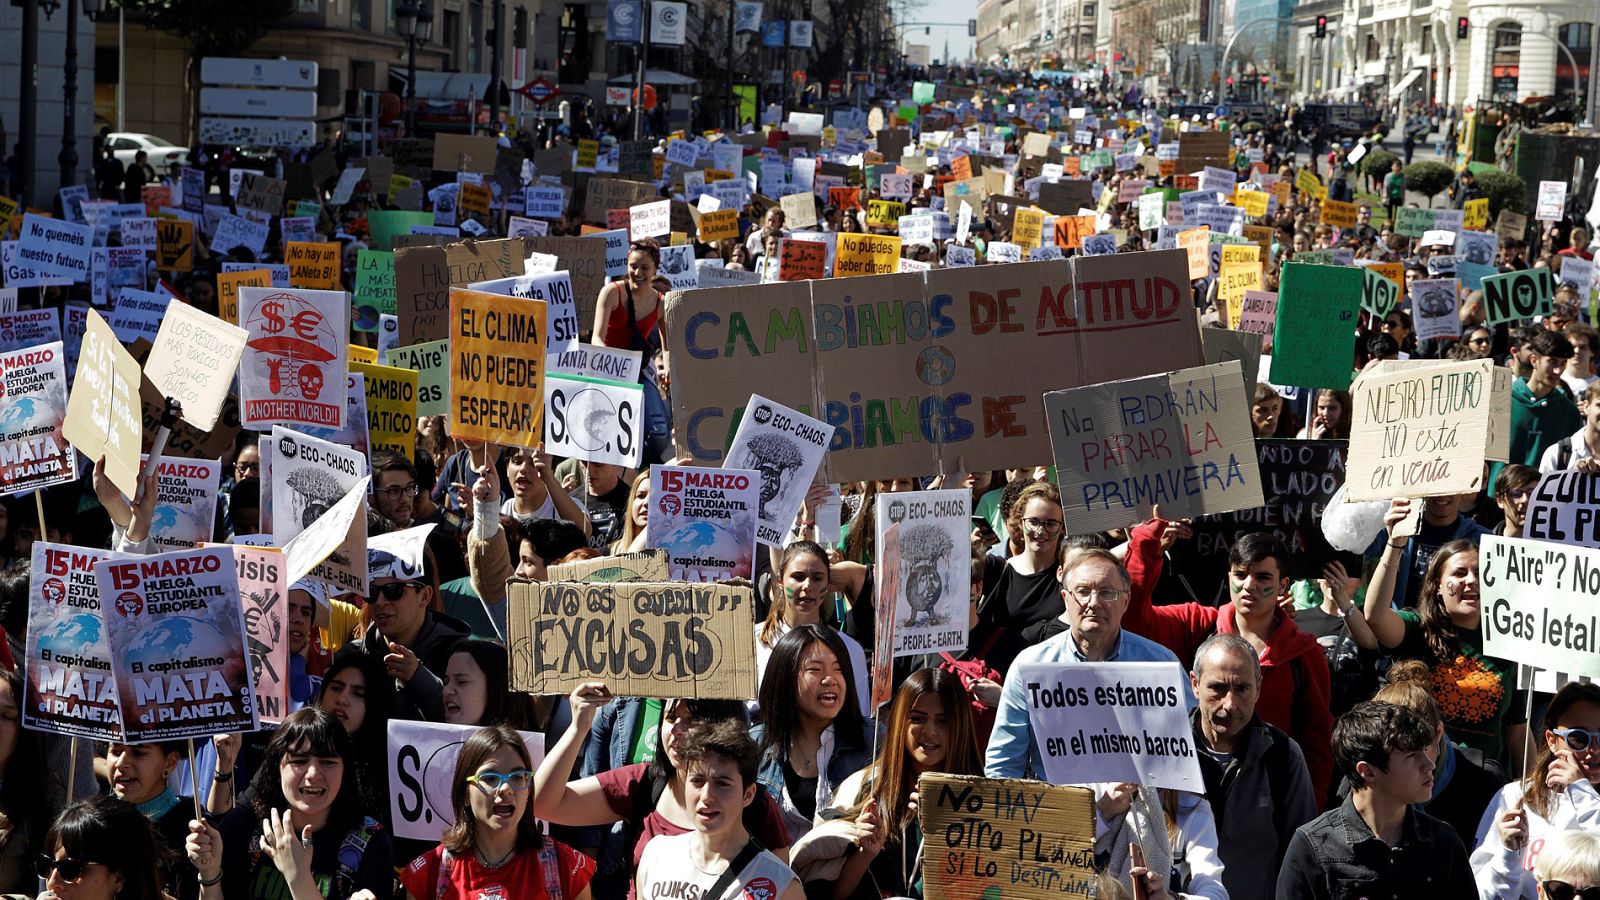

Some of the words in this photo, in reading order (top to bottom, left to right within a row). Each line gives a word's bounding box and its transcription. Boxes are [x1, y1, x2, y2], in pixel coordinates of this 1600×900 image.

[528, 192, 535, 200] EL
[535, 191, 561, 200] PROBLEMA
[650, 220, 666, 231] CLIMA
[703, 213, 713, 222] No
[713, 211, 726, 221] hay
[31, 223, 43, 237] No
[46, 228, 85, 246] queméis
[305, 245, 321, 263] hay
[323, 247, 335, 258] un
[842, 238, 856, 251] No
[858, 239, 893, 255] puedes
[1224, 251, 1233, 262] EL
[1234, 251, 1255, 262] CLIMA
[20, 248, 53, 263] nuestro
[56, 252, 86, 271] futuro.
[362, 256, 378, 271] LA
[837, 257, 863, 271] beber
[864, 258, 894, 274] dinero.
[1228, 275, 1237, 289] EL
[1237, 271, 1257, 289] CLIMA
[118, 295, 138, 307] Todos
[549, 280, 572, 305] NO!
[1363, 274, 1397, 316] NO!
[1484, 272, 1550, 322] NO!
[1243, 298, 1264, 313] CAMBIA
[0, 315, 14, 329] 15
[13, 312, 52, 324] MARZO
[14, 321, 39, 329] HUELGA
[460, 308, 481, 339] EL
[485, 310, 538, 345] CLIMA
[554, 309, 577, 342] SÍ!
[684, 293, 957, 361] CAMBIAMOS
[968, 288, 1025, 336] DE
[1037, 276, 1182, 330] ACTITUD
[15, 326, 53, 335] ESTUDIANTIL
[16, 332, 45, 341] EUROPEA
[170, 318, 192, 338] LOS
[191, 327, 234, 359] RESIDUOS
[4, 350, 54, 370] MARZO
[460, 352, 482, 382] NO
[486, 355, 537, 389] PUEDE
[557, 350, 588, 370] TANTA
[591, 352, 632, 378] CARNE
[5, 368, 38, 380] HUELGA
[6, 371, 56, 389] ESTUDIANTIL
[7, 383, 45, 397] EUROPEA
[364, 380, 414, 401] CAMBIO
[1364, 378, 1426, 425] NUESTRO
[1429, 370, 1484, 416] FUTURO
[249, 399, 297, 419] ANOTHER
[298, 402, 338, 424] WORLD!!
[460, 395, 536, 434] ESPERAR.
[755, 406, 770, 421] STOP
[982, 396, 1026, 438] DE
[7, 425, 56, 442] capitalismo
[1381, 422, 1407, 459] NO
[1415, 419, 1459, 454] está
[0, 435, 61, 467] MATA
[281, 439, 296, 455] STOP
[1080, 427, 1172, 472] PARAR
[1183, 421, 1223, 457] LA
[15, 459, 63, 478] PLANETA
[156, 462, 210, 480] MARZO
[1370, 463, 1393, 490] en
[1402, 455, 1451, 486] venta
[158, 476, 188, 487] UELGA
[660, 470, 683, 493] 15
[685, 472, 750, 491] MARZO
[1082, 453, 1246, 512] PRIMAVERA
[1271, 471, 1337, 496] LADO
[158, 494, 193, 505] UROPEA
[683, 498, 748, 511] ESTUDIANTIL
[684, 489, 726, 500] HUELGA
[683, 508, 732, 520] EUROPEA
[889, 505, 905, 518] STOP
[1529, 505, 1566, 540] EL
[45, 550, 69, 576] 15
[673, 555, 736, 569] capitalismo
[108, 563, 141, 591] 15
[141, 555, 221, 581] MARZO
[1572, 554, 1600, 596] No
[143, 576, 195, 592] HUELGA
[145, 583, 226, 602] ESTUDIANTIL
[147, 598, 208, 616] EUROPEA
[543, 588, 580, 617] NO
[586, 588, 616, 615] OS
[1484, 597, 1535, 642] ¡Gas
[41, 649, 51, 661] El
[532, 617, 715, 679] EXCUSAS
[131, 662, 143, 674] El
[149, 655, 225, 675] capitalismo
[40, 666, 117, 706] MATA
[132, 670, 233, 707] MATA
[1027, 681, 1089, 709] Todos
[1094, 680, 1178, 708] estamos
[38, 699, 51, 713] el
[54, 700, 121, 725] PLANETA
[140, 709, 154, 724] el
[159, 700, 236, 721] PLANETA
[1046, 736, 1068, 757] en
[1070, 729, 1086, 756] el
[1090, 728, 1141, 756] mismo
[1144, 729, 1194, 758] barco.
[994, 788, 1046, 824] HAY
